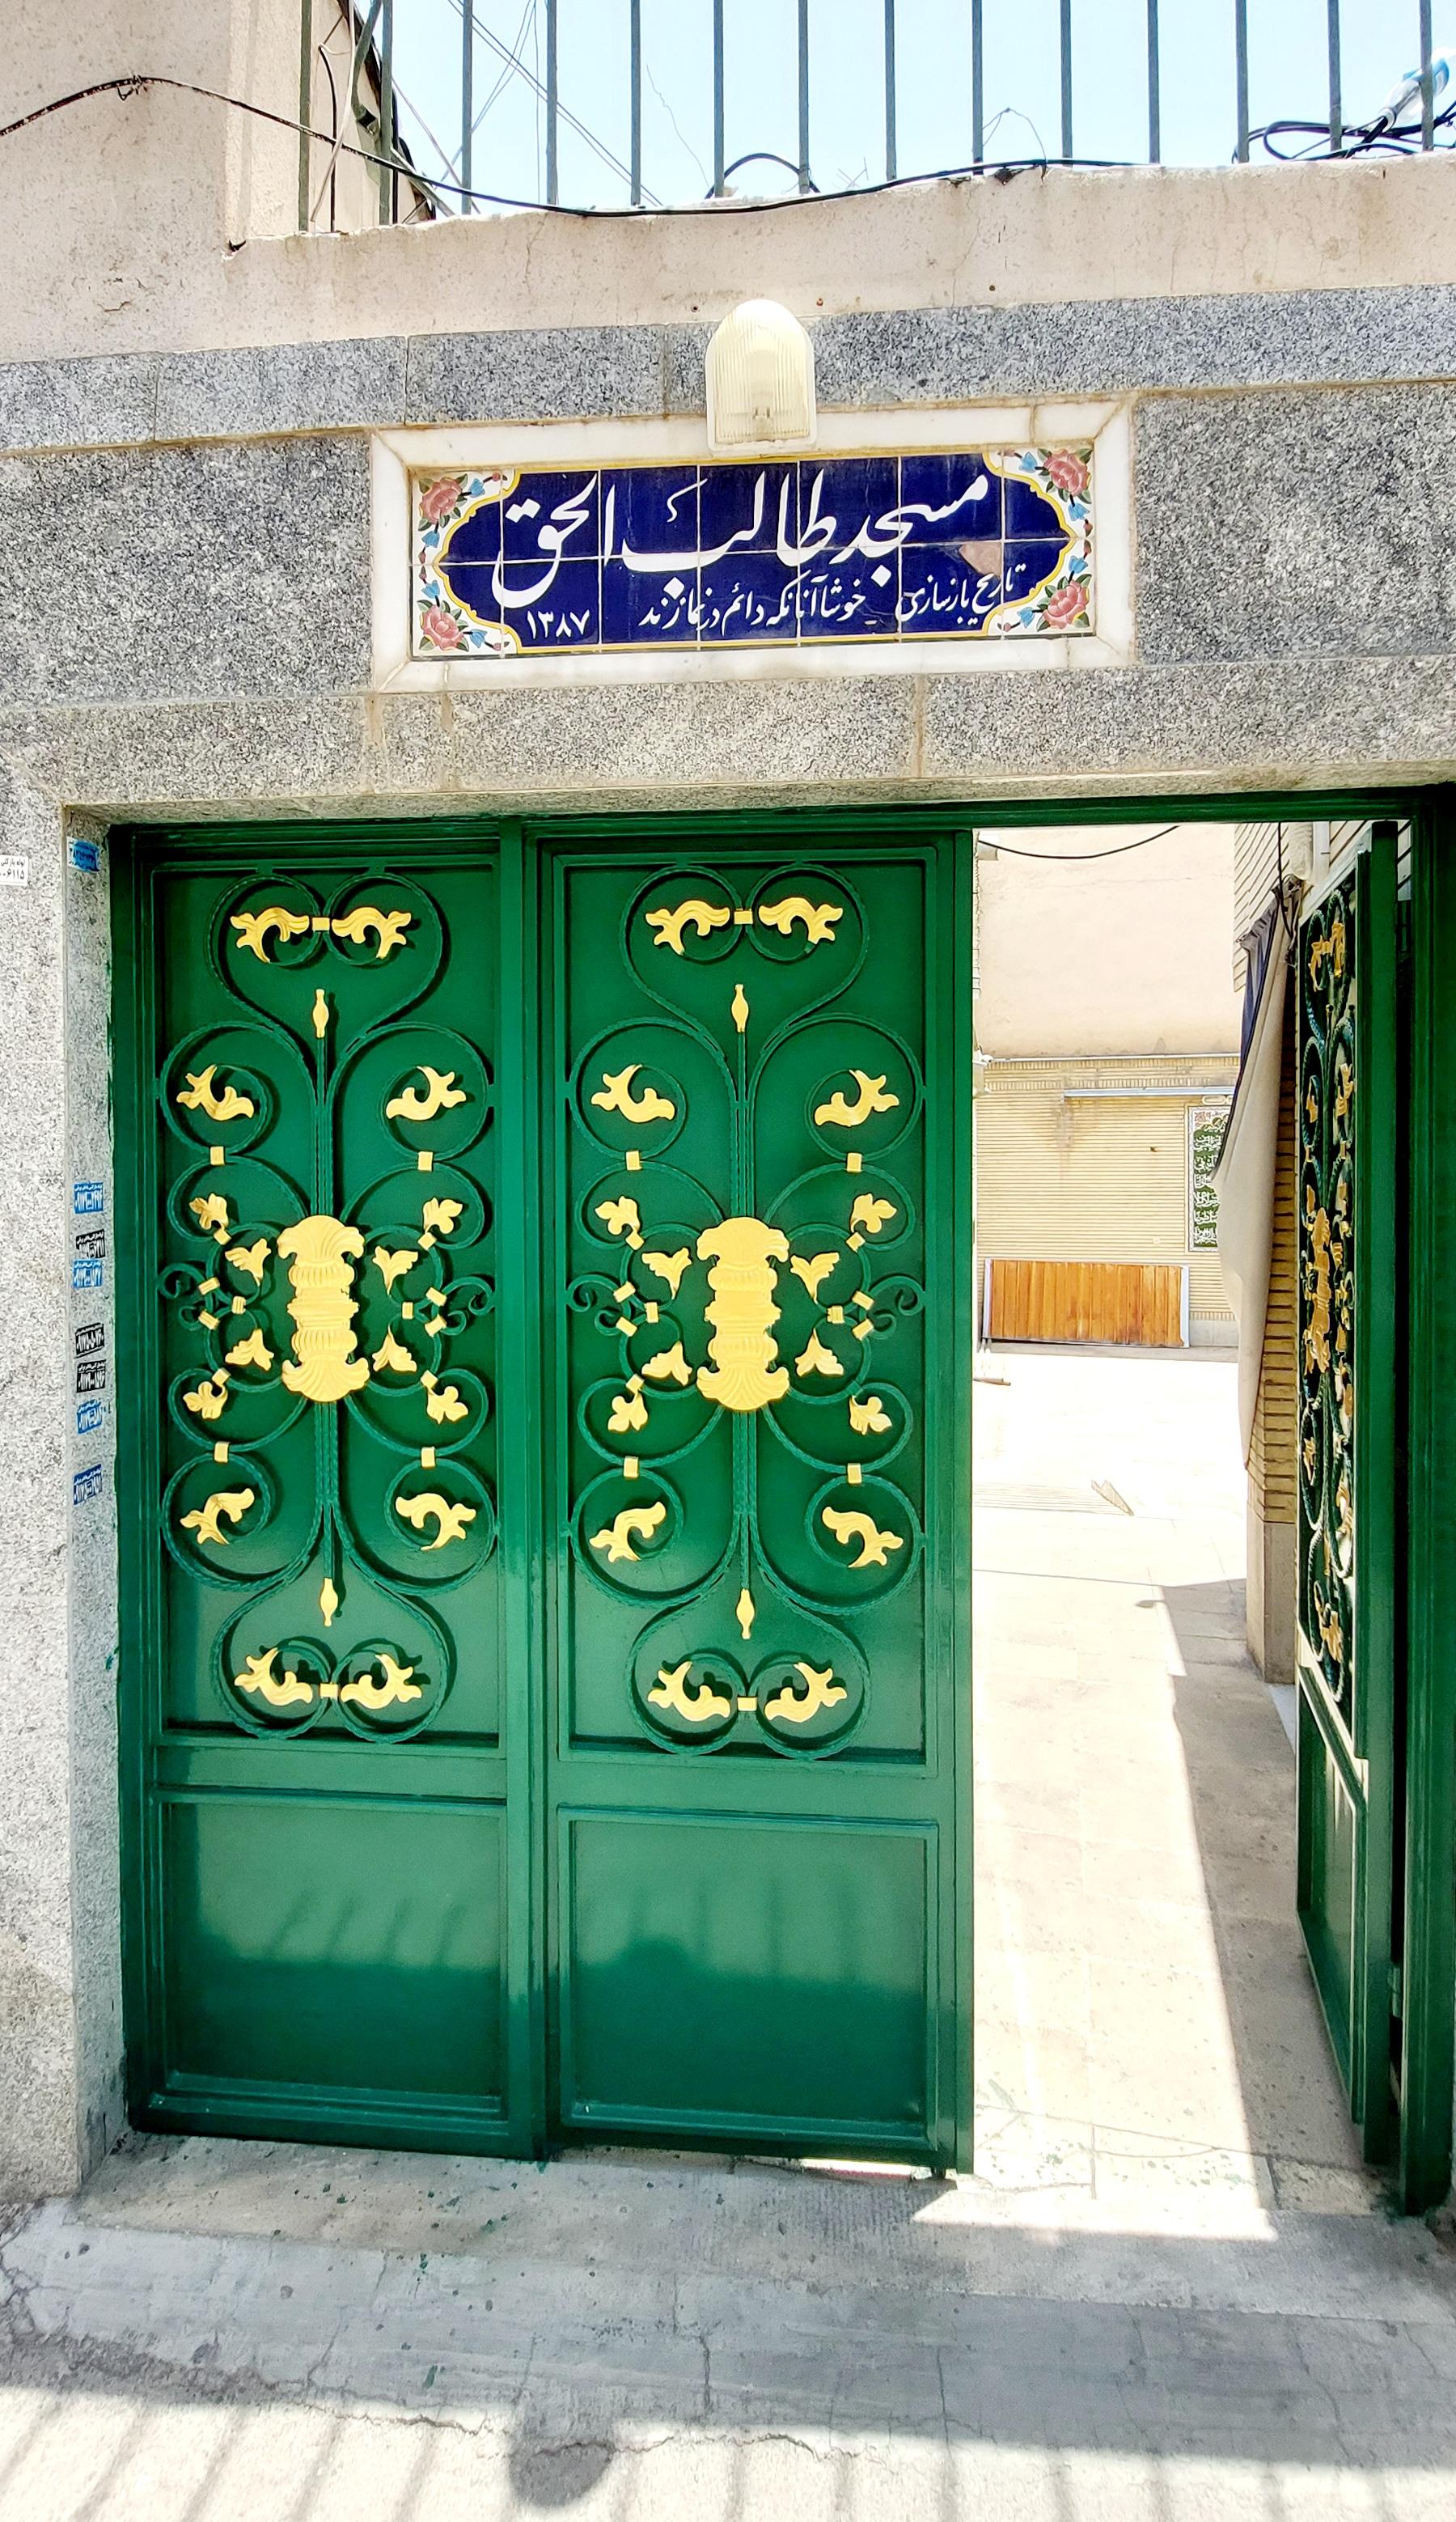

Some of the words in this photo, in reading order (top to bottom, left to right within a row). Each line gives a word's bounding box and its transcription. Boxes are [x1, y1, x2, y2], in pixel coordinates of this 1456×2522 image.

[491, 473, 615, 609] الحق
[622, 468, 837, 600] طالب
[829, 474, 988, 587] مسجد
[527, 609, 590, 640] ۱۳۸۷
[722, 582, 764, 637] دائم
[820, 578, 866, 621] خوشا
[895, 575, 971, 625] بازسازی
